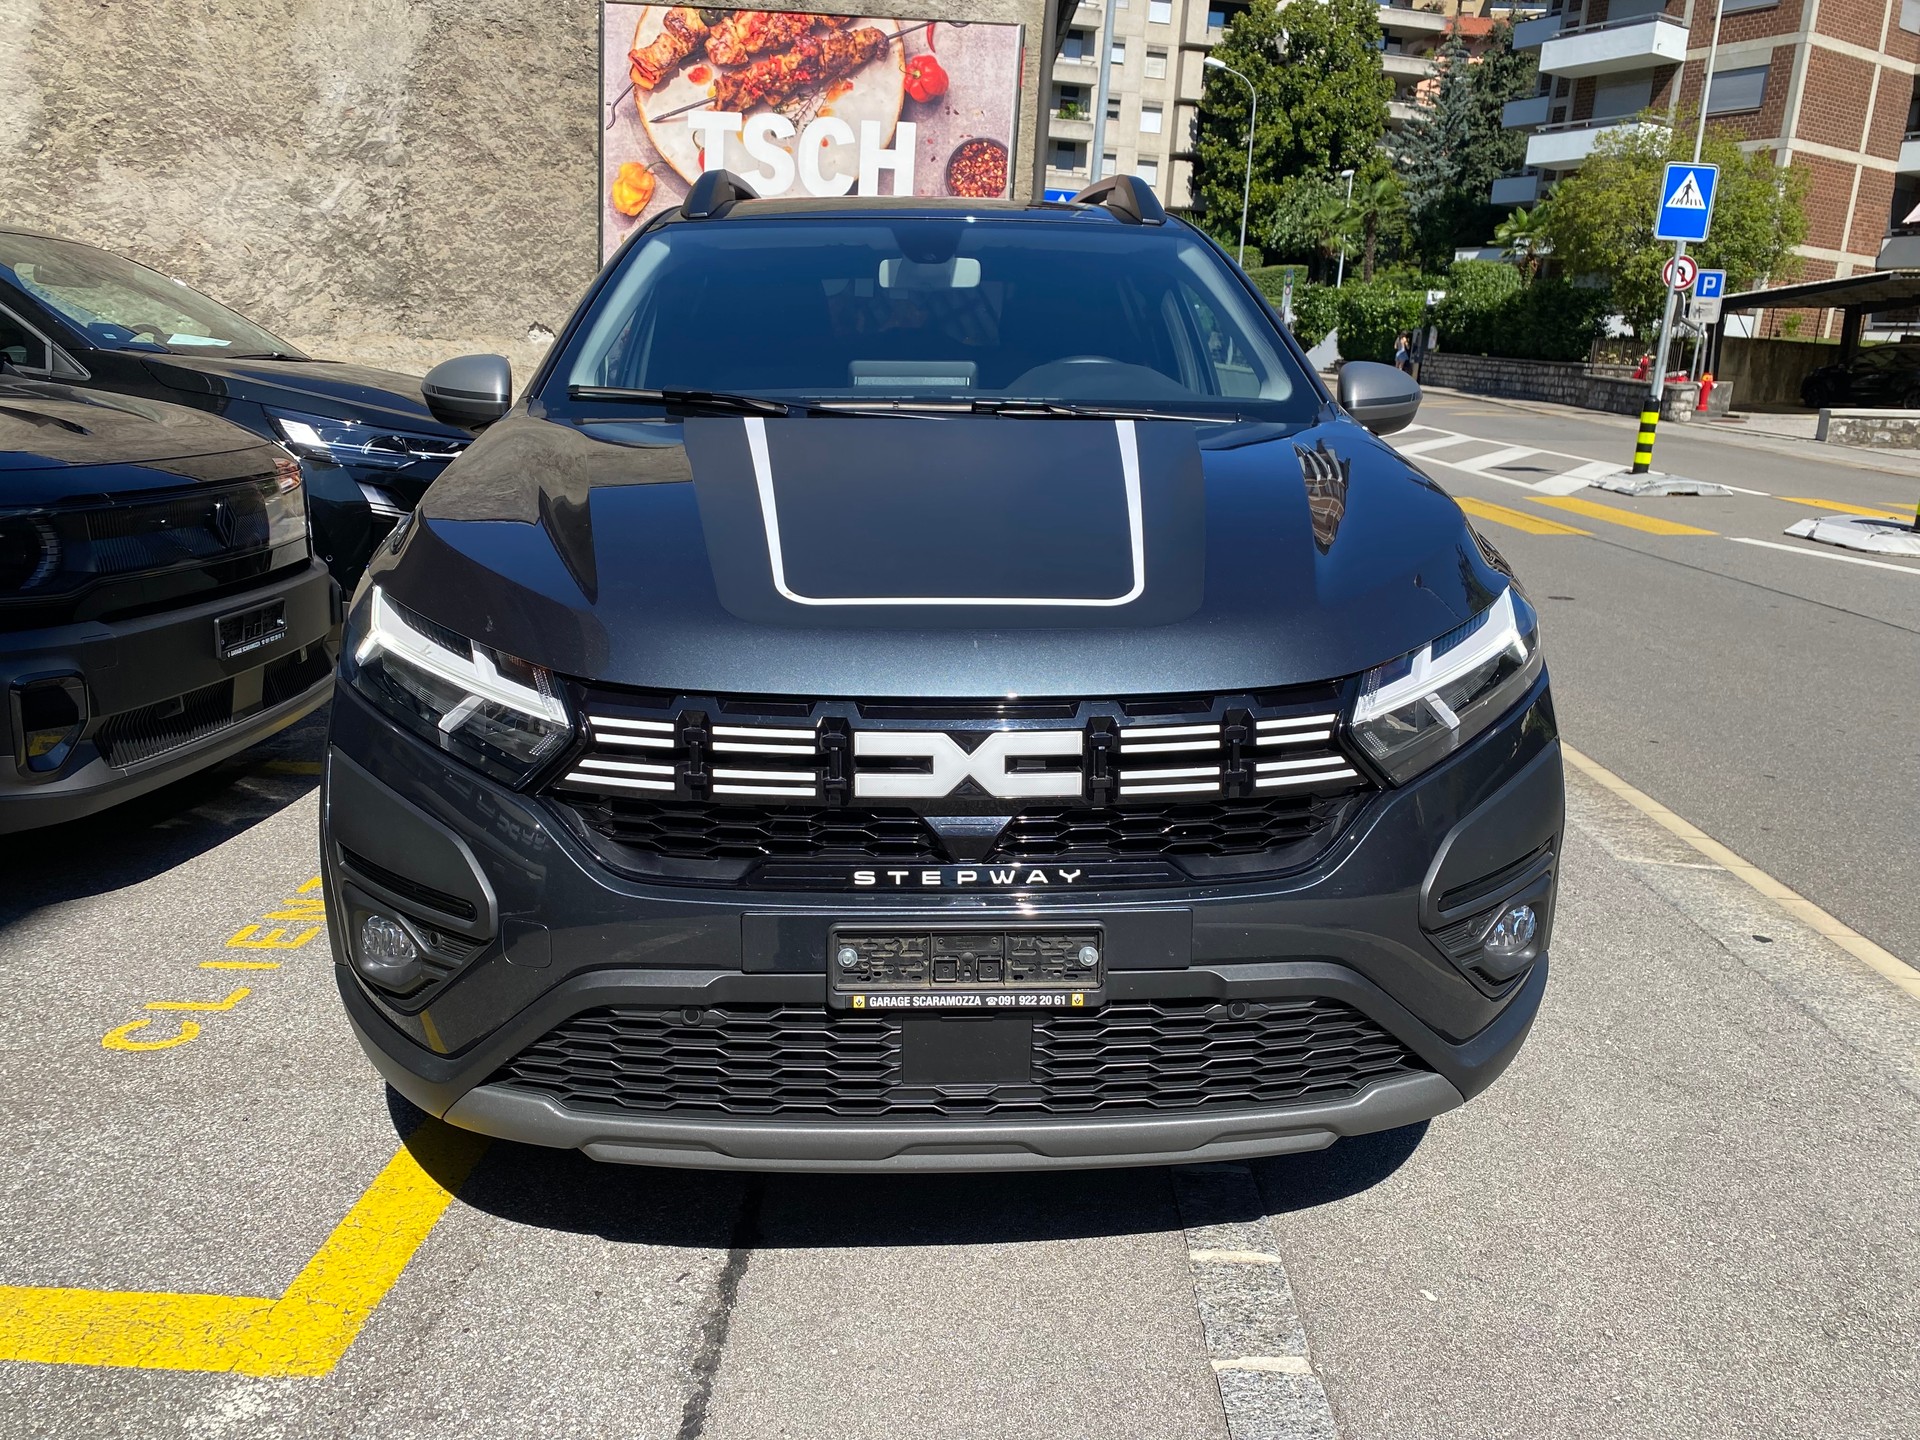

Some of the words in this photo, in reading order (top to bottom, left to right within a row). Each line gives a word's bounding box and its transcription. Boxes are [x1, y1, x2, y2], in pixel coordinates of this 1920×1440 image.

[687, 110, 917, 197] TSCH
[1702, 276, 1717, 295] P
[853, 869, 1081, 885] STEPWAY
[101, 876, 327, 1052] CLIEN
[869, 996, 911, 1007] GARAGE
[912, 995, 982, 1007] SCARAMOZZA
[998, 995, 1015, 1005] 091
[1018, 995, 1038, 1005] 922
[1039, 995, 1052, 1005] 20
[1054, 994, 1066, 1005] 61
